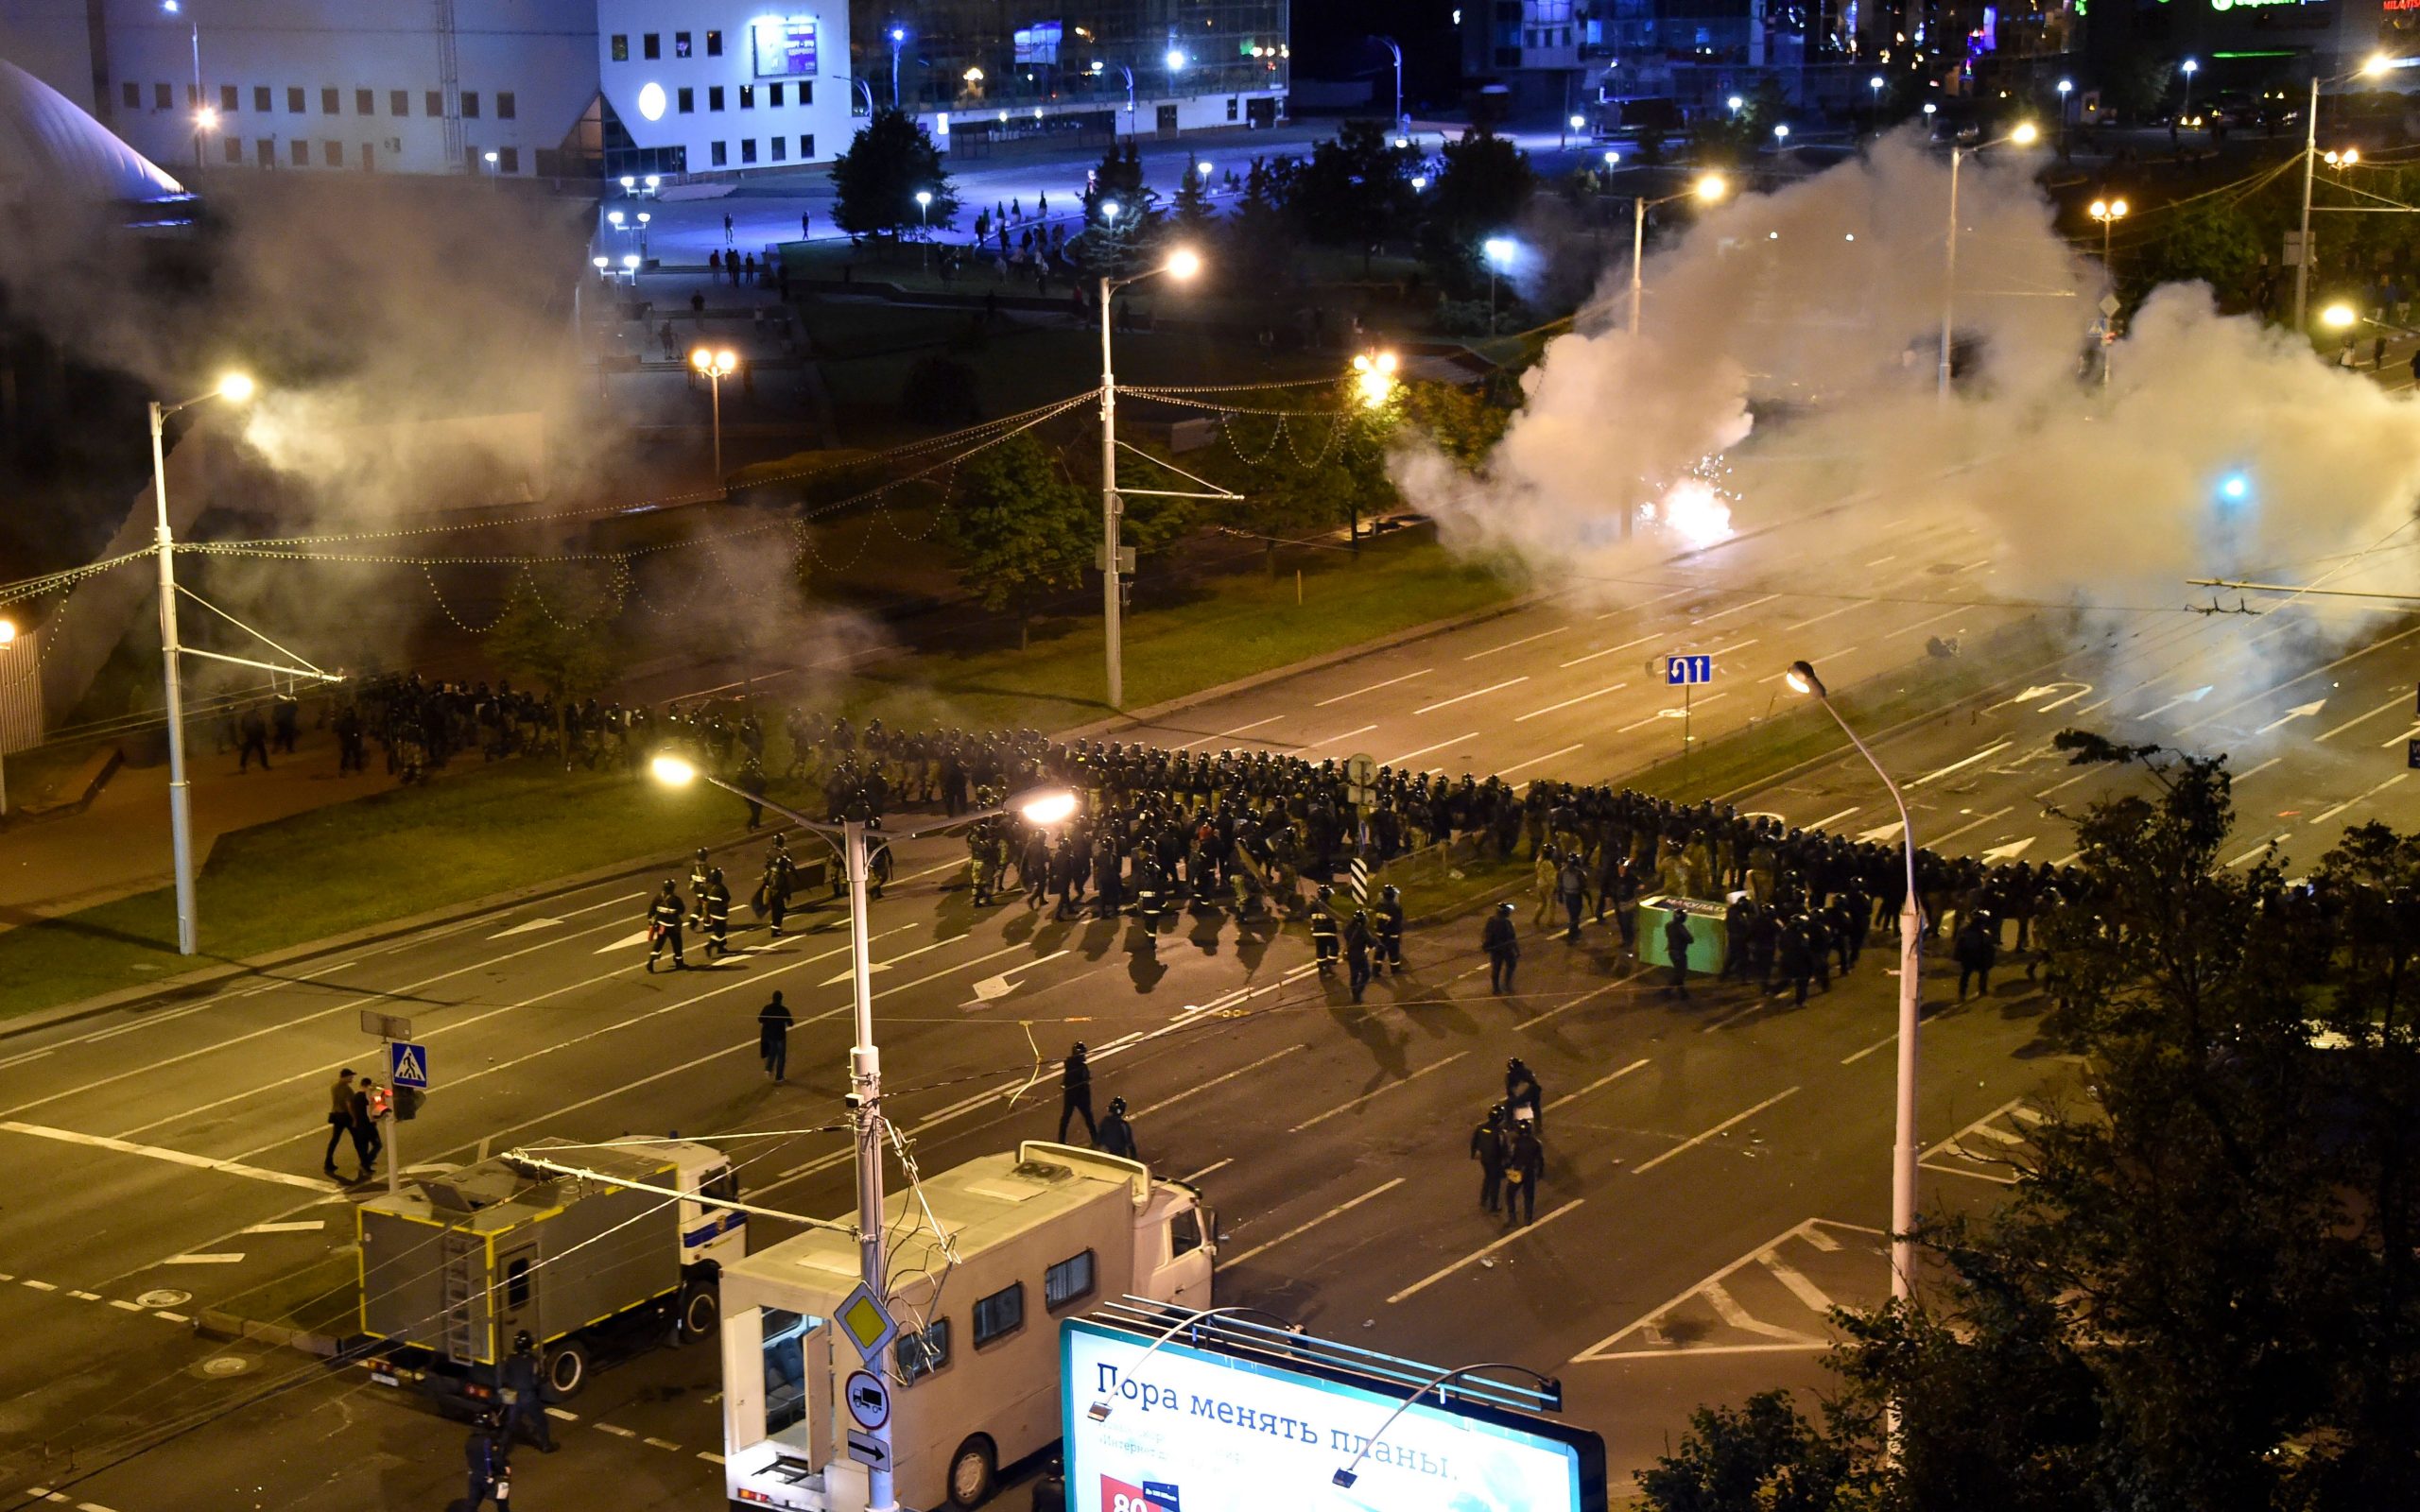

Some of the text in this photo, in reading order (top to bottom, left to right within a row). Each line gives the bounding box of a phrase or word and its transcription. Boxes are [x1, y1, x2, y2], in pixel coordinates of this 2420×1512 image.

[1097, 1362, 1179, 1412] Пора
[1189, 1394, 1319, 1445] менять
[1330, 1428, 1459, 1482] планы.
